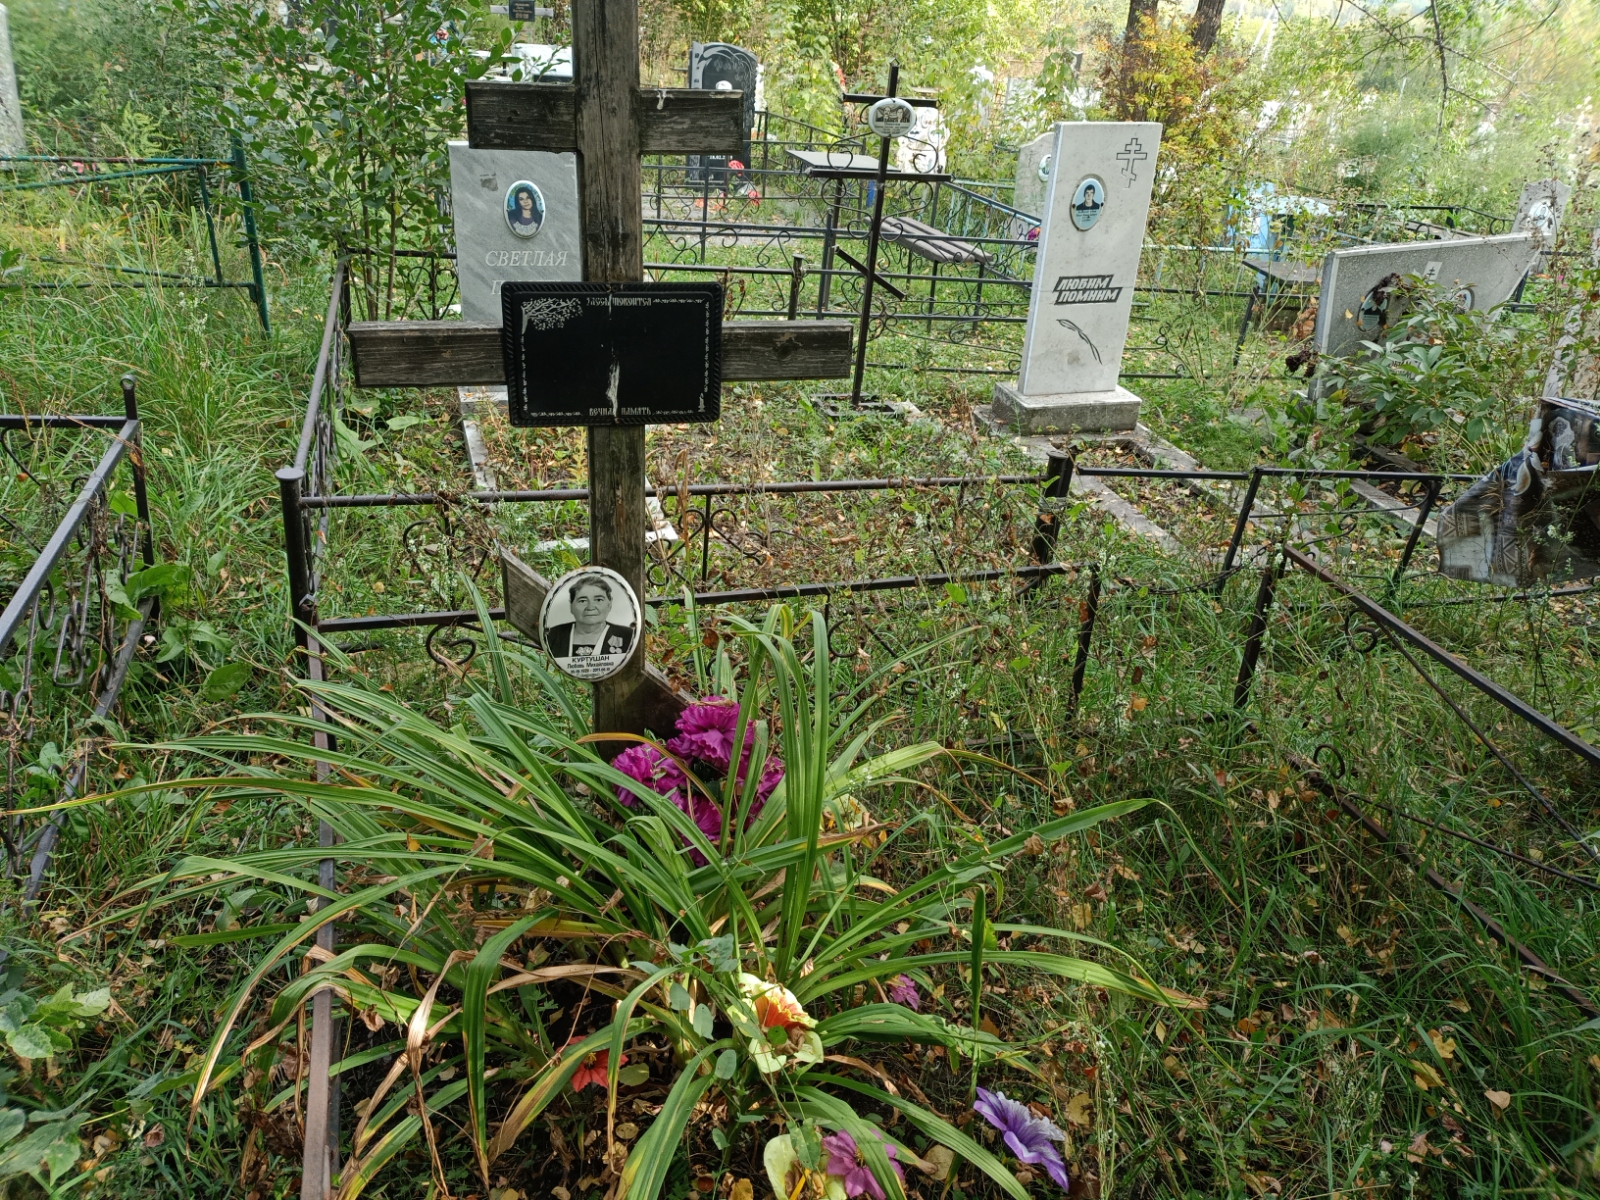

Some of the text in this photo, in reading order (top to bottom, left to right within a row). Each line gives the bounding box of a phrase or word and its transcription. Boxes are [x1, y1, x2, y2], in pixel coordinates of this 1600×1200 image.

[485, 250, 569, 267] СВЕТЛАЯ
[1057, 277, 1111, 291] ЛЮБИМ
[1058, 288, 1120, 303] ПОМНИМ
[572, 655, 610, 663] КУРТУШАН
